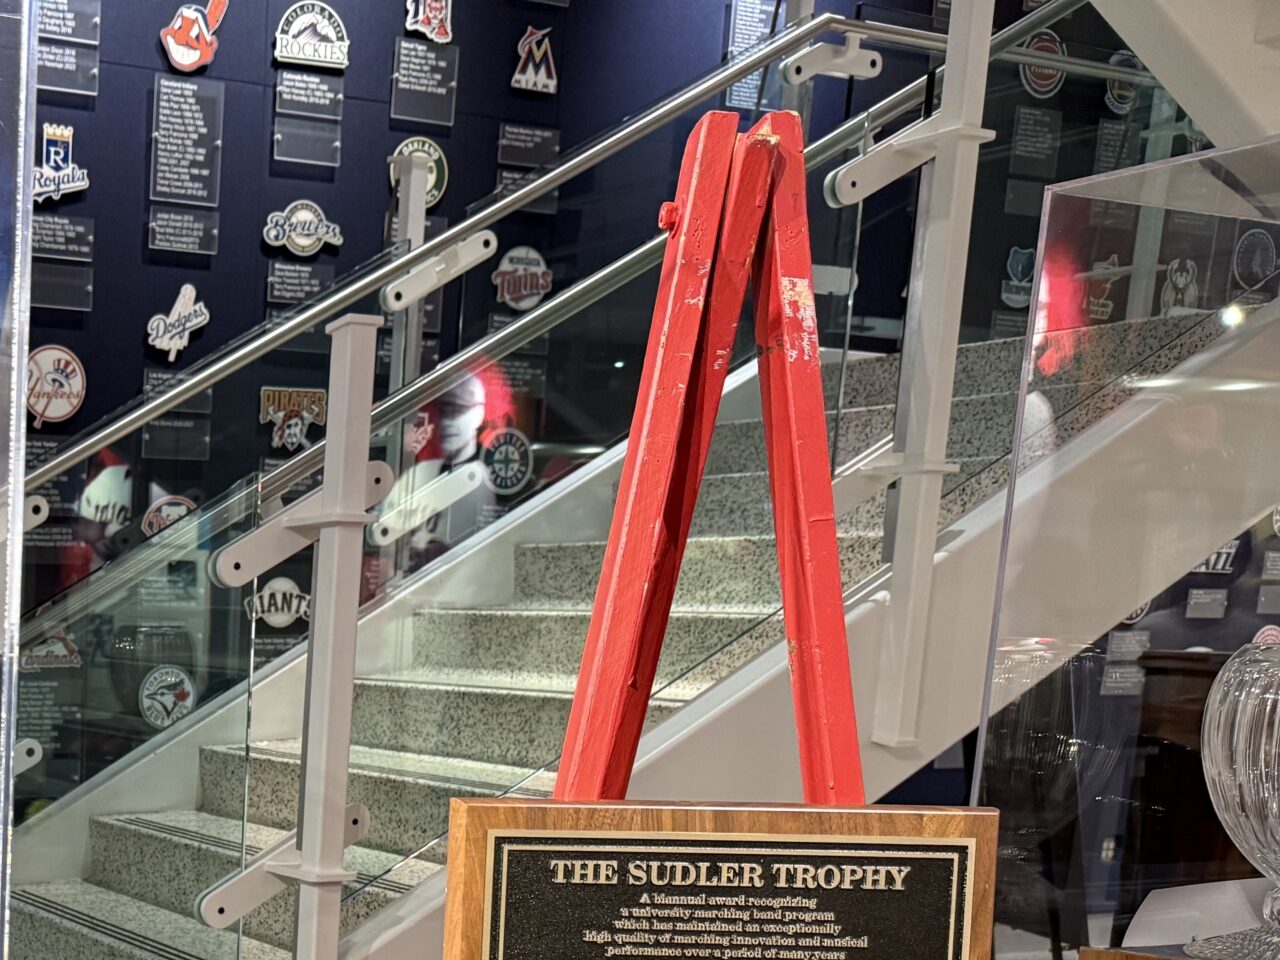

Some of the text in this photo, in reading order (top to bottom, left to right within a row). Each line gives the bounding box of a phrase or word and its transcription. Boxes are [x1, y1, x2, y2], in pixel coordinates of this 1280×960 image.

[283, 4, 343, 38] COLORADO
[280, 37, 346, 61] ROCKIES
[48, 147, 65, 168] R
[33, 165, 88, 195] Royals
[267, 214, 338, 241] Brewers
[494, 270, 551, 303] Twins
[150, 303, 205, 342] Dodgers
[262, 389, 326, 424] PIRATES
[550, 860, 911, 891] THE SUDLER TROPHY
[639, 893, 818, 909] A biannual award recognizing
[613, 920, 842, 935] which has maintained an exceptionally
[631, 908, 691, 920] university
[694, 909, 750, 921] marching
[753, 909, 782, 920] band
[783, 912, 835, 922] program
[583, 930, 868, 948] high quality of marching innovation and musical
[605, 946, 682, 957] performance
[683, 948, 712, 957] over
[722, 948, 762, 960] period
[763, 949, 778, 959] of
